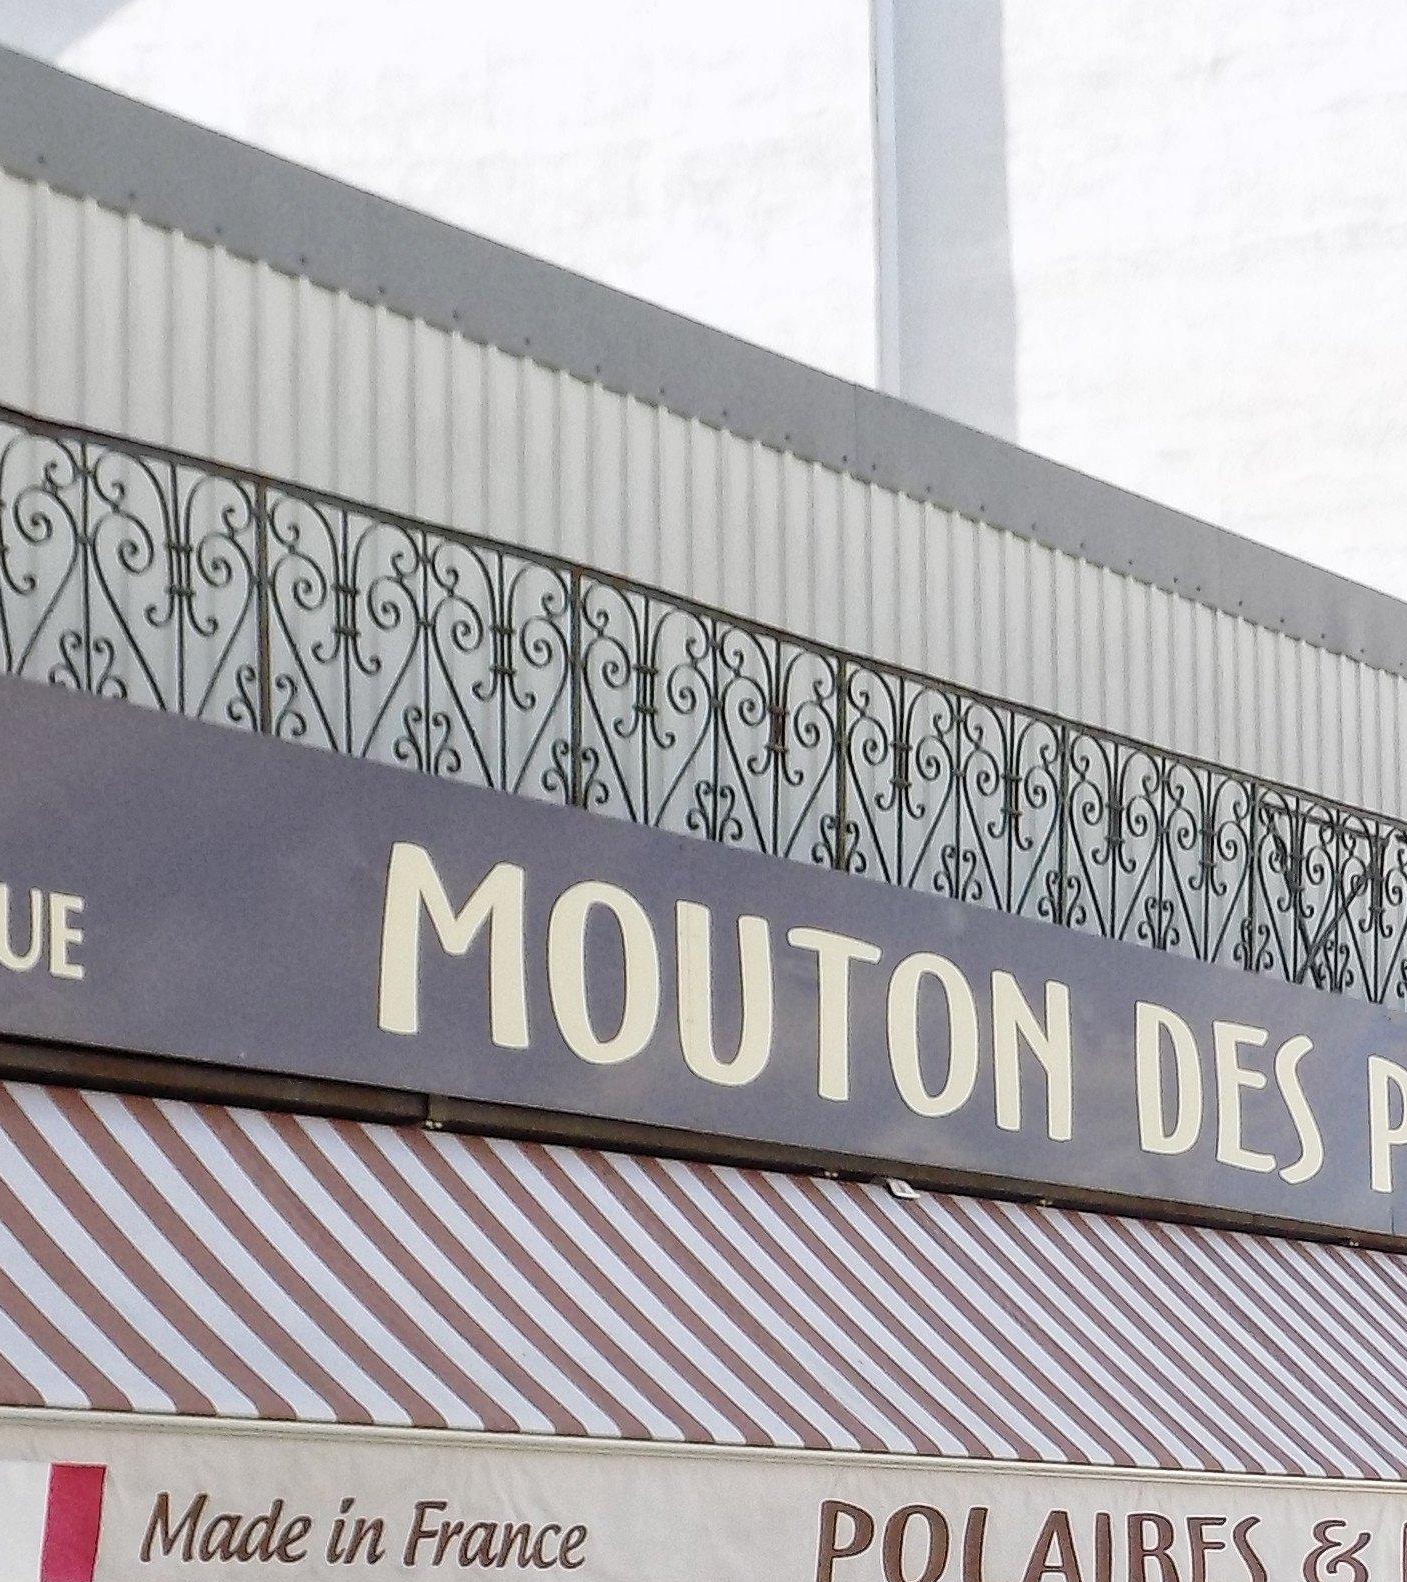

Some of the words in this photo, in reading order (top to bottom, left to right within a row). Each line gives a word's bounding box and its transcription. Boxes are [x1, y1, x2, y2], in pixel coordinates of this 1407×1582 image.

[377, 841, 1074, 1143] MOUTON
[1133, 1000, 1324, 1184] DES
[139, 1490, 313, 1565] Made
[324, 1495, 387, 1566] in
[402, 1499, 590, 1571] France
